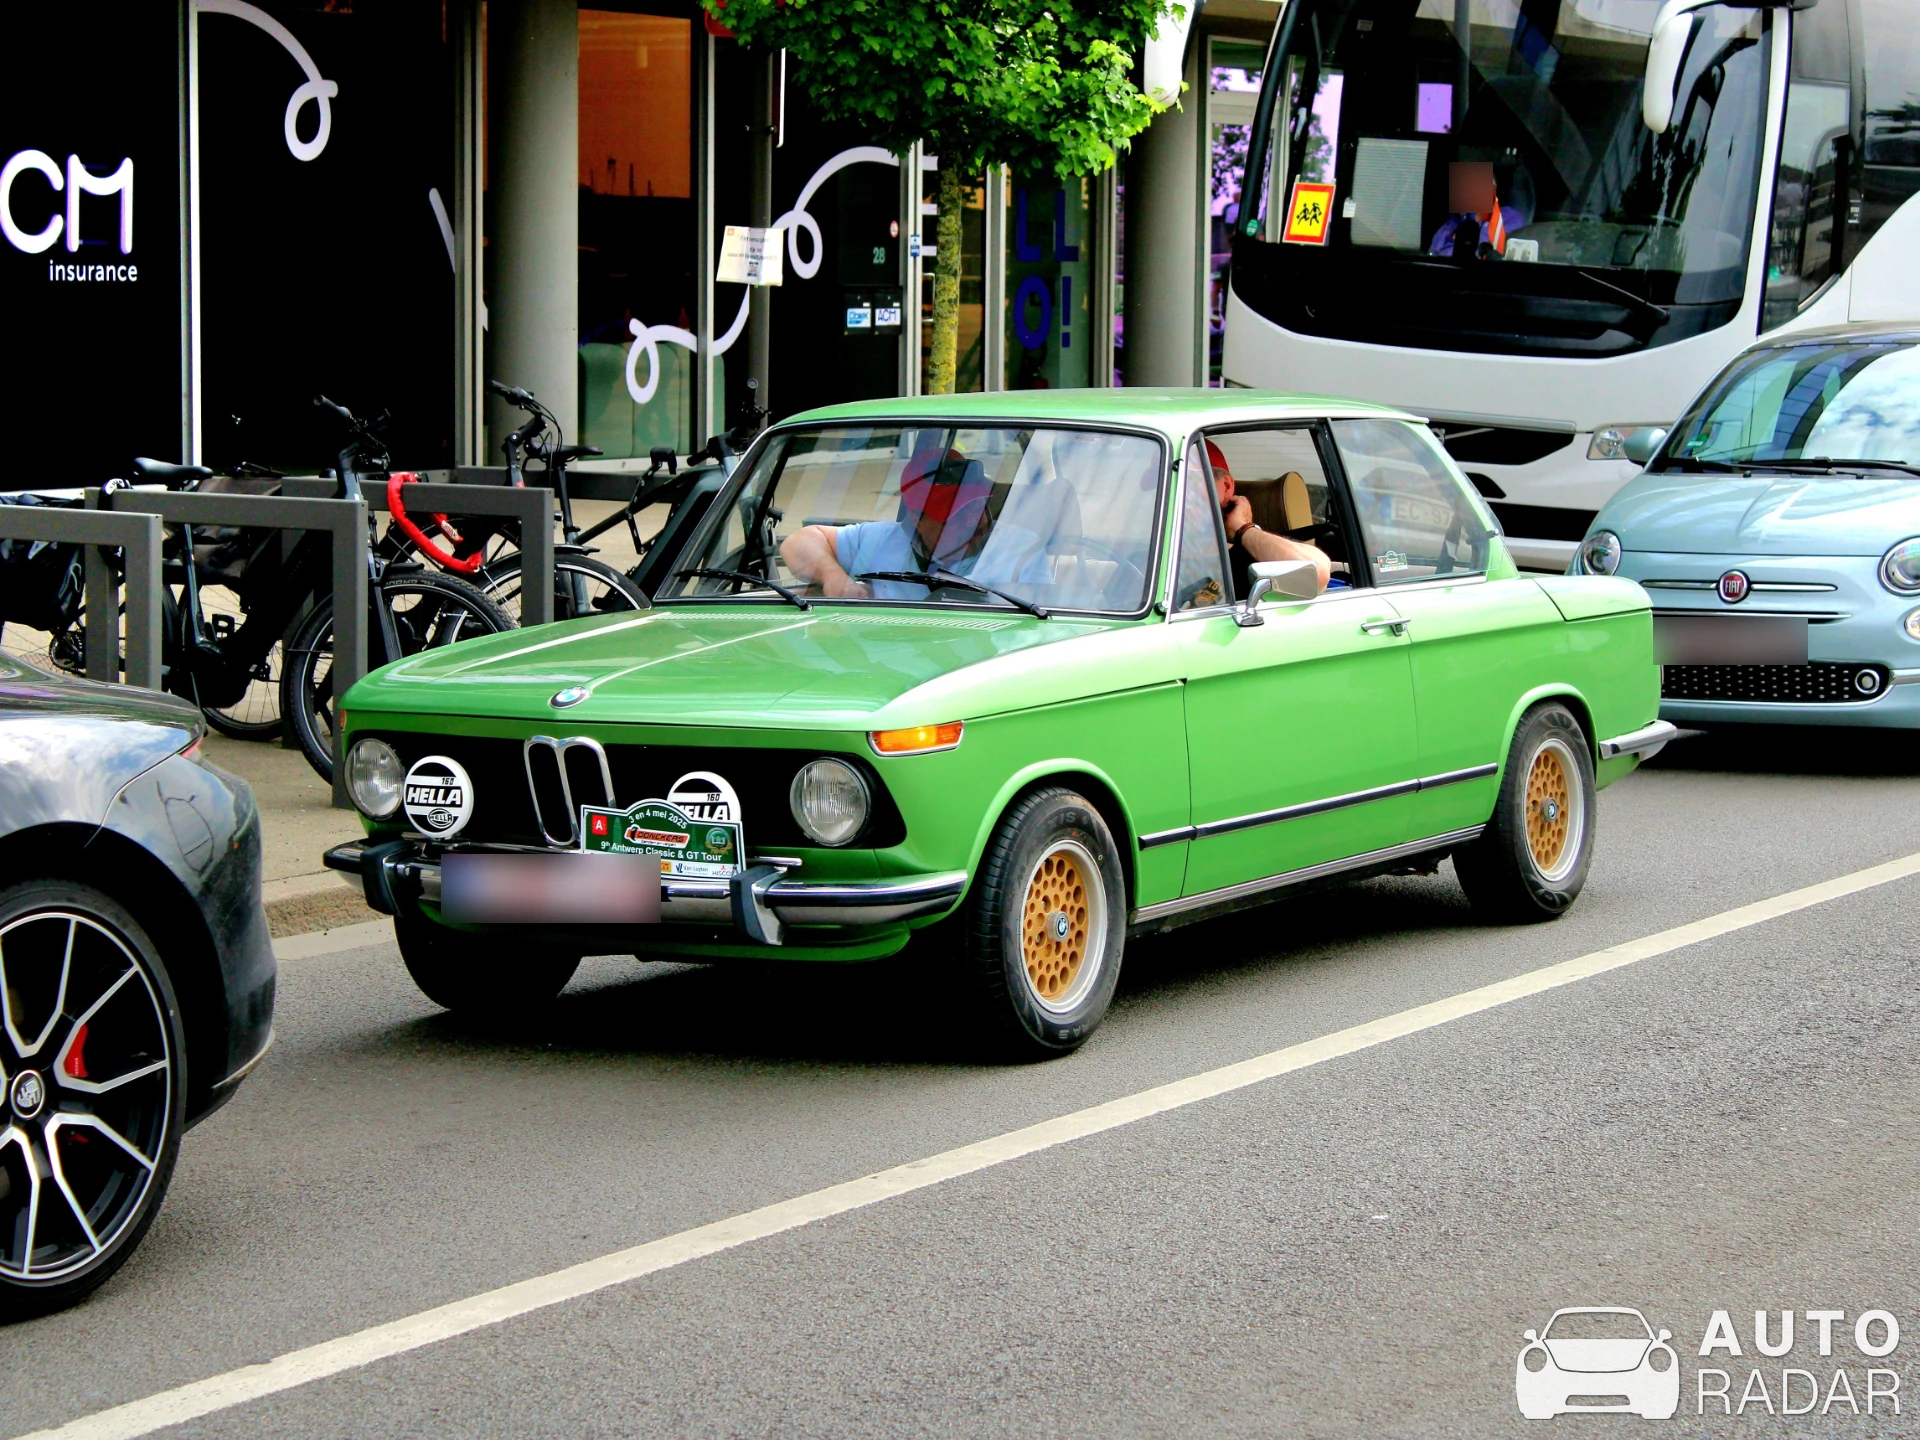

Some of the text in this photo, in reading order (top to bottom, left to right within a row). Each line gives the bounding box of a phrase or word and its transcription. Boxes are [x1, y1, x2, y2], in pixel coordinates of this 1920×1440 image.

[0, 149, 133, 254] CM
[873, 246, 886, 264] 28
[49, 259, 138, 282] insurance
[877, 308, 897, 322] ACM
[1725, 580, 1741, 594] FIAT
[441, 777, 455, 786] 160
[406, 786, 462, 805] HELLA
[707, 793, 721, 802] 160
[595, 819, 604, 831] A
[628, 808, 688, 829] 3 en 4 mei 2025
[637, 830, 685, 843] DONCKERS
[600, 841, 723, 861] 9th Antwerp Classic & GT Tour
